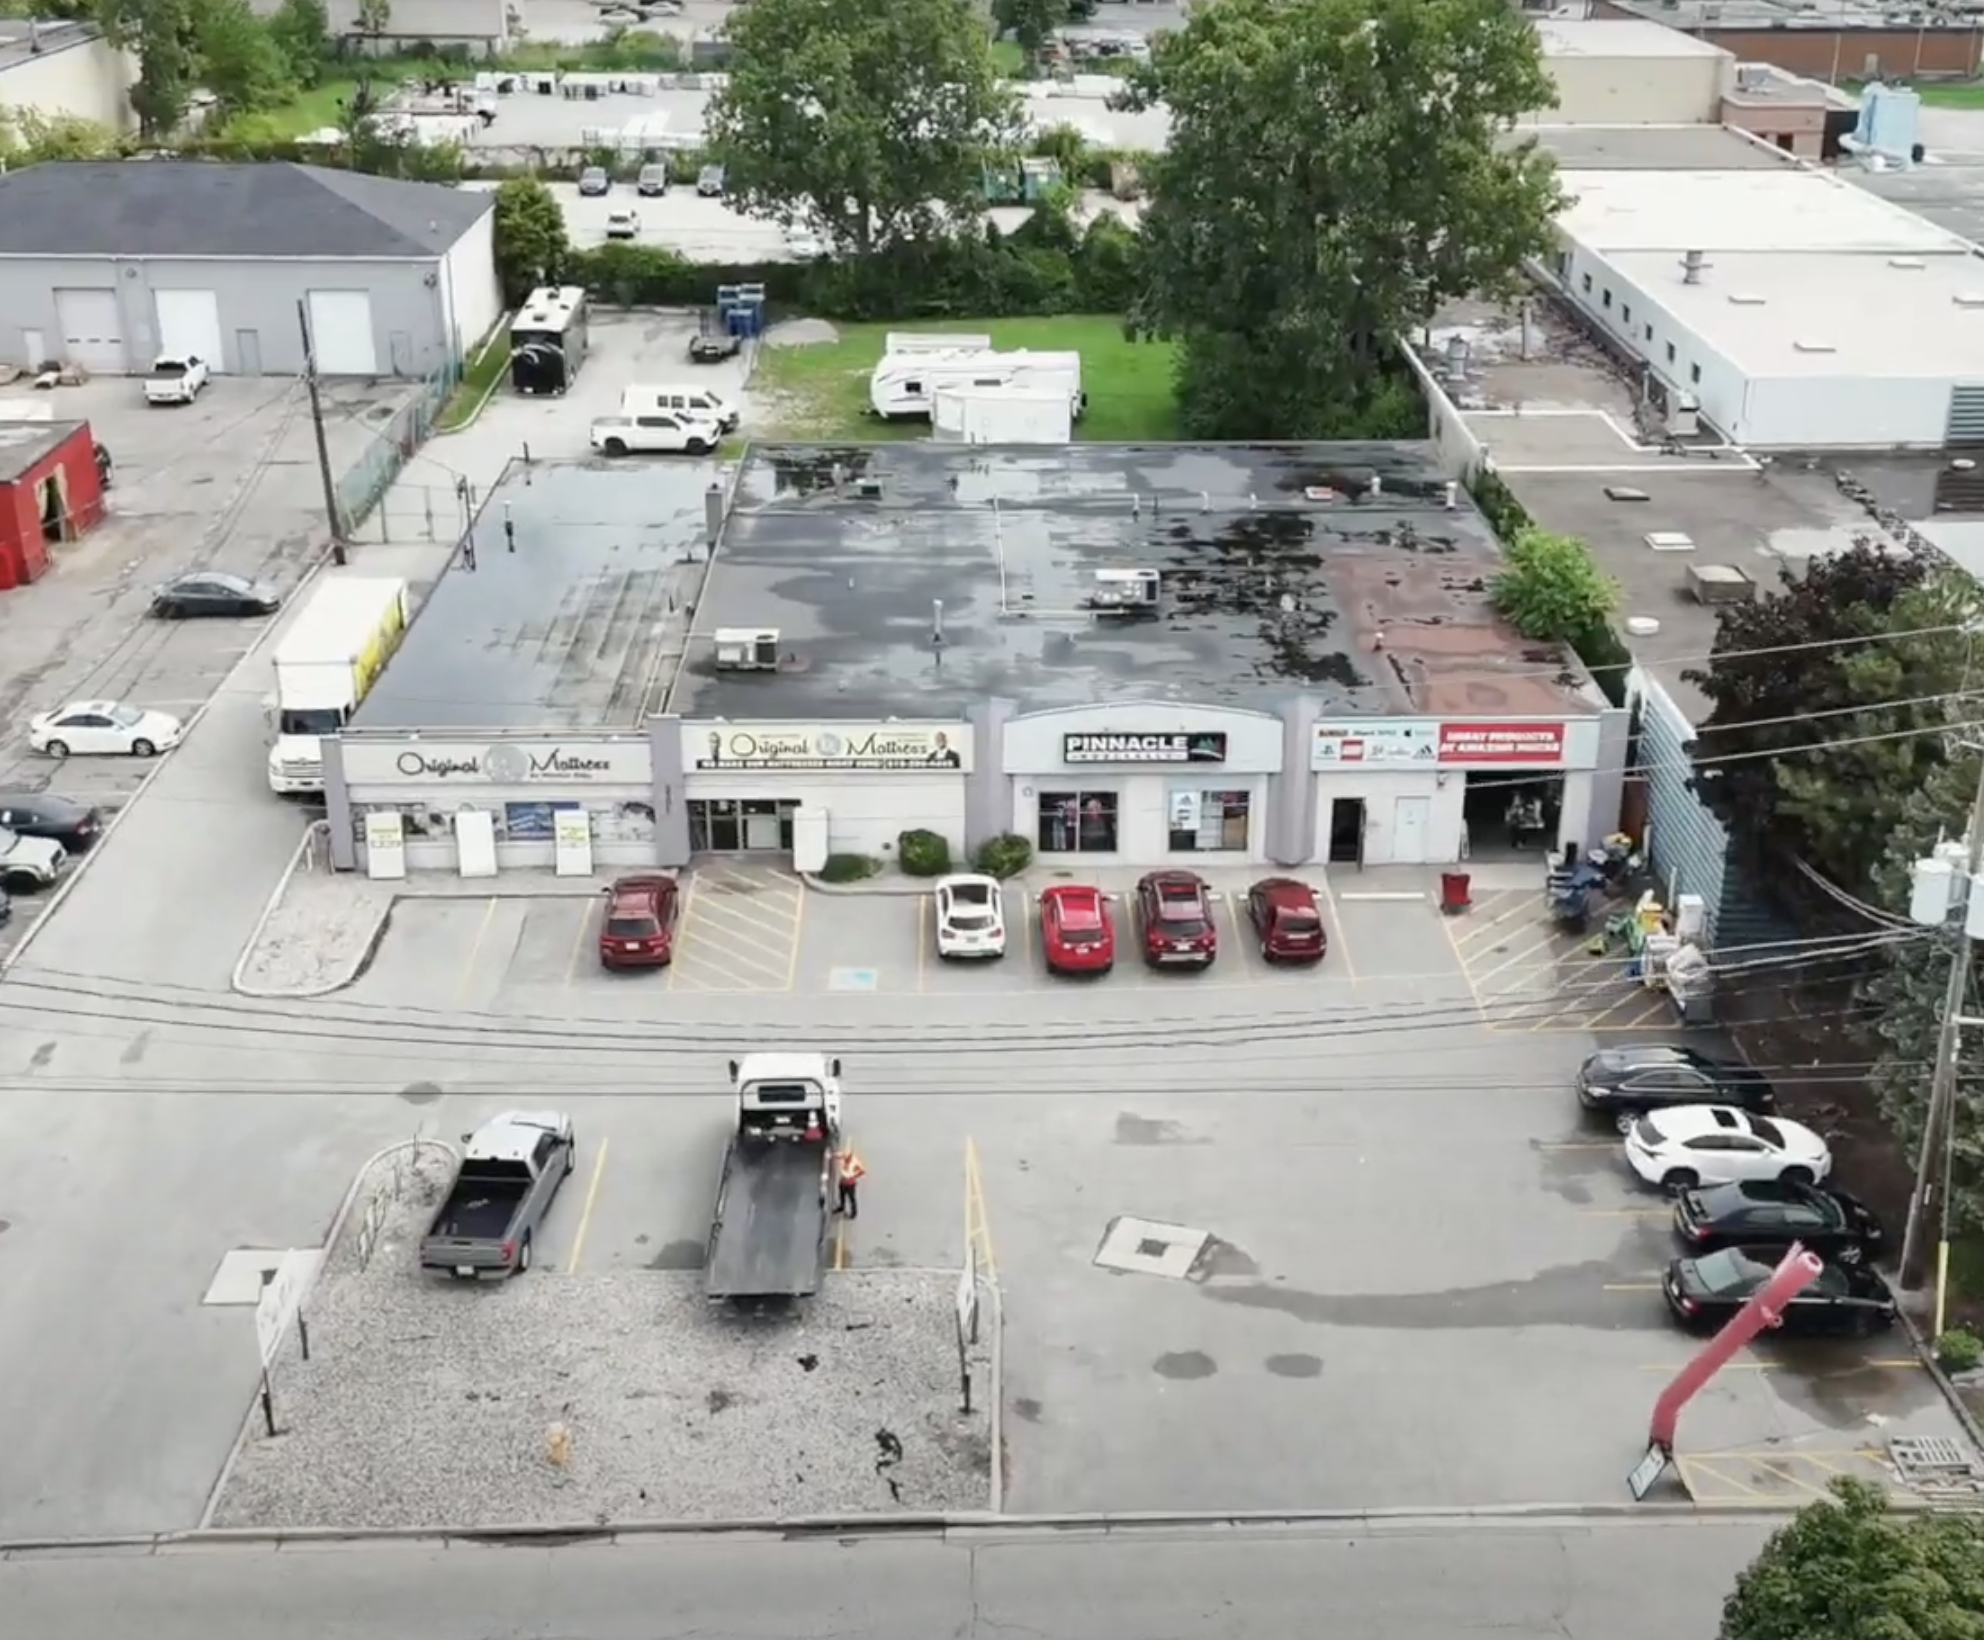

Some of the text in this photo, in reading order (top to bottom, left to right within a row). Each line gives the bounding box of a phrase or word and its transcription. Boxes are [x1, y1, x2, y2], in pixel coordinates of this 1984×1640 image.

[730, 731, 927, 759] Original Mattress
[1066, 736, 1189, 751] PINNACLE
[397, 748, 610, 778] Original Mattress
